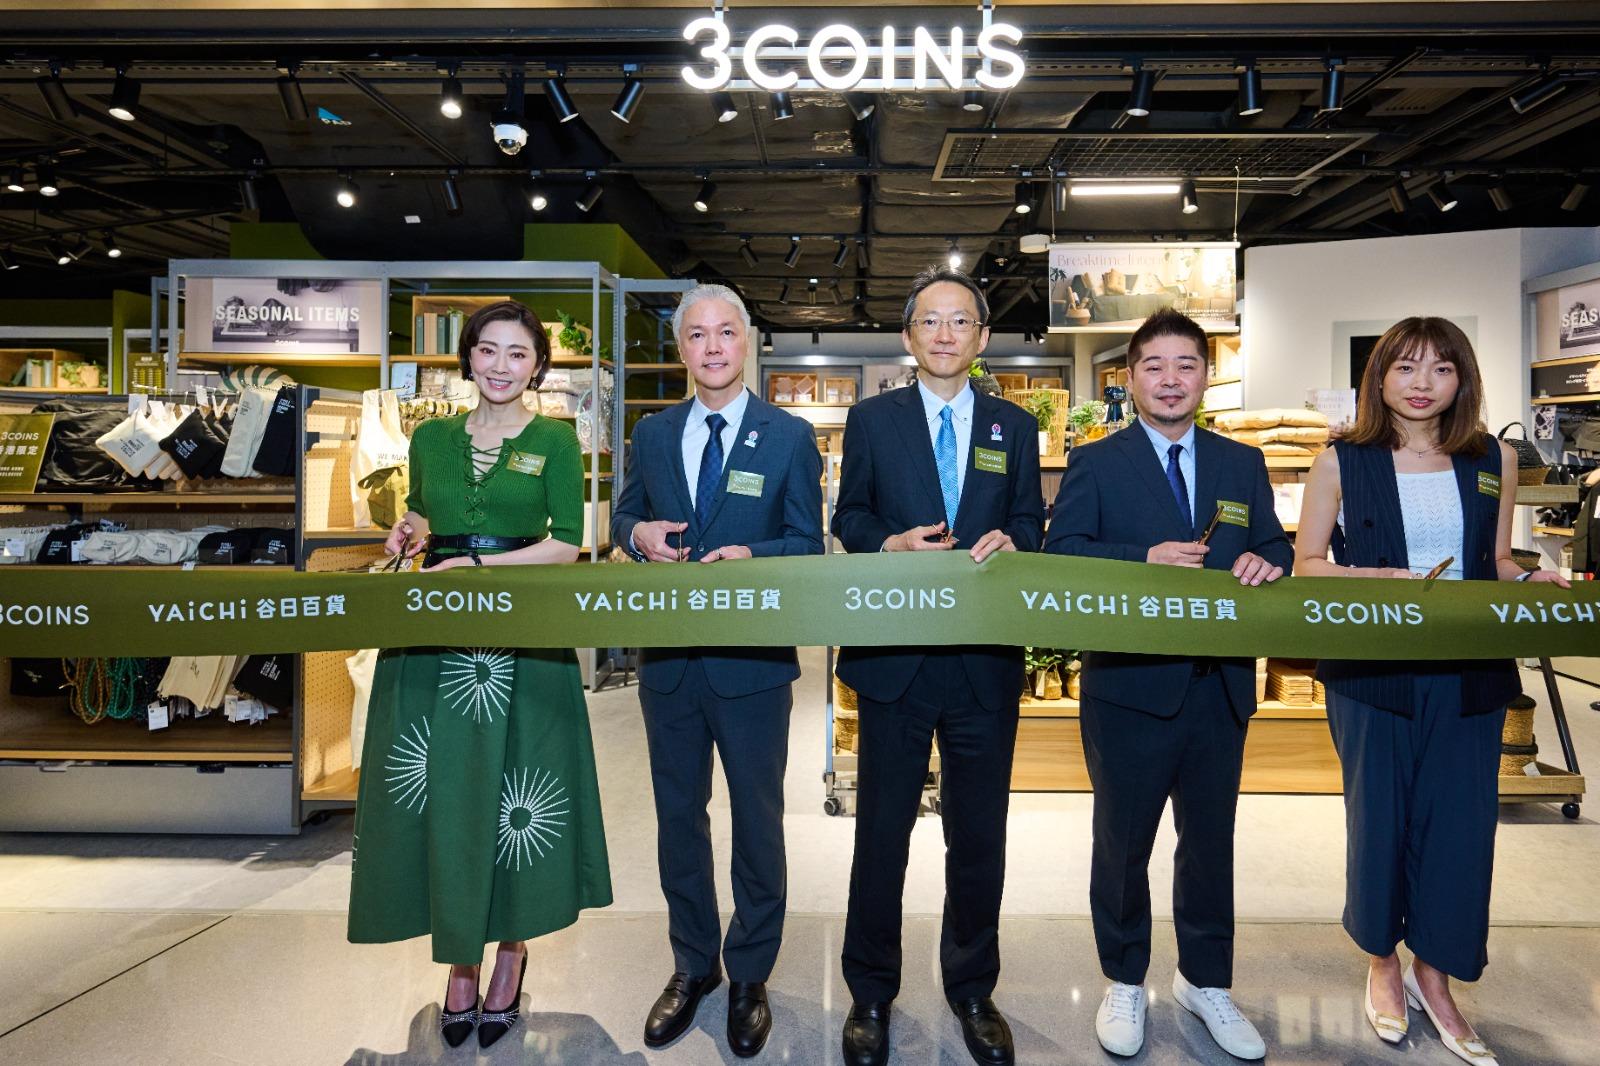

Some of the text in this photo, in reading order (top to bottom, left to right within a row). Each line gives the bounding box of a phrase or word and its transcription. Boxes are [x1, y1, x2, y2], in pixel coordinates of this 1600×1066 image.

[681, 17, 1026, 90] 3COINS
[215, 305, 360, 322] SEASONAL ITEMS
[2, 431, 39, 441] 3COINS
[148, 594, 346, 622] YAiCHi 谷日百貨
[406, 588, 512, 612] 3COINS
[575, 588, 781, 611] YAiCHi 谷日百貨
[845, 587, 955, 610] 3COINS
[1021, 591, 1238, 620] YAiCHi 谷日百貨
[0, 604, 89, 625] COINS
[1304, 599, 1424, 625] 3COINS
